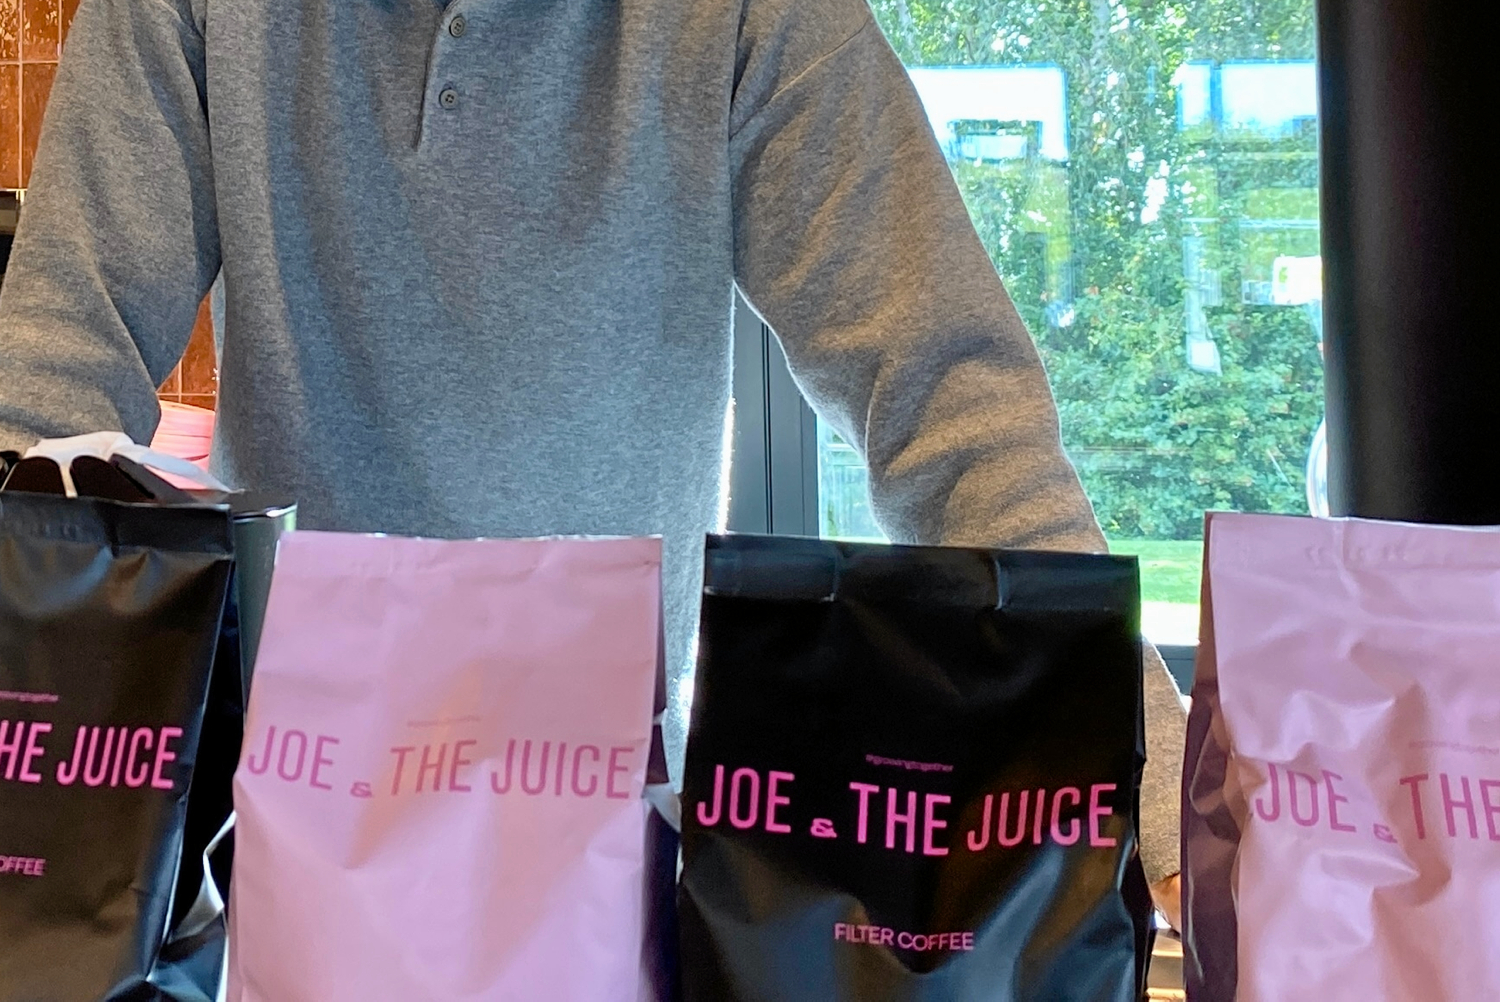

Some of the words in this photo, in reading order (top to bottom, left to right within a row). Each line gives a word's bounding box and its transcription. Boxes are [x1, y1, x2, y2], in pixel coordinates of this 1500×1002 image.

[56, 726, 184, 791] JUICE
[247, 725, 341, 791] JOE
[349, 781, 374, 798] &
[389, 739, 478, 797] THE
[490, 738, 636, 800] JUICE
[696, 764, 796, 835] JOE
[809, 817, 838, 840] &
[848, 781, 952, 857] THE
[966, 782, 1119, 853] JUICE
[1255, 762, 1357, 833] JOE
[1372, 823, 1398, 844] &
[1399, 773, 1500, 842] THE
[834, 922, 895, 947] FILTER
[897, 931, 975, 952] COFFEE
